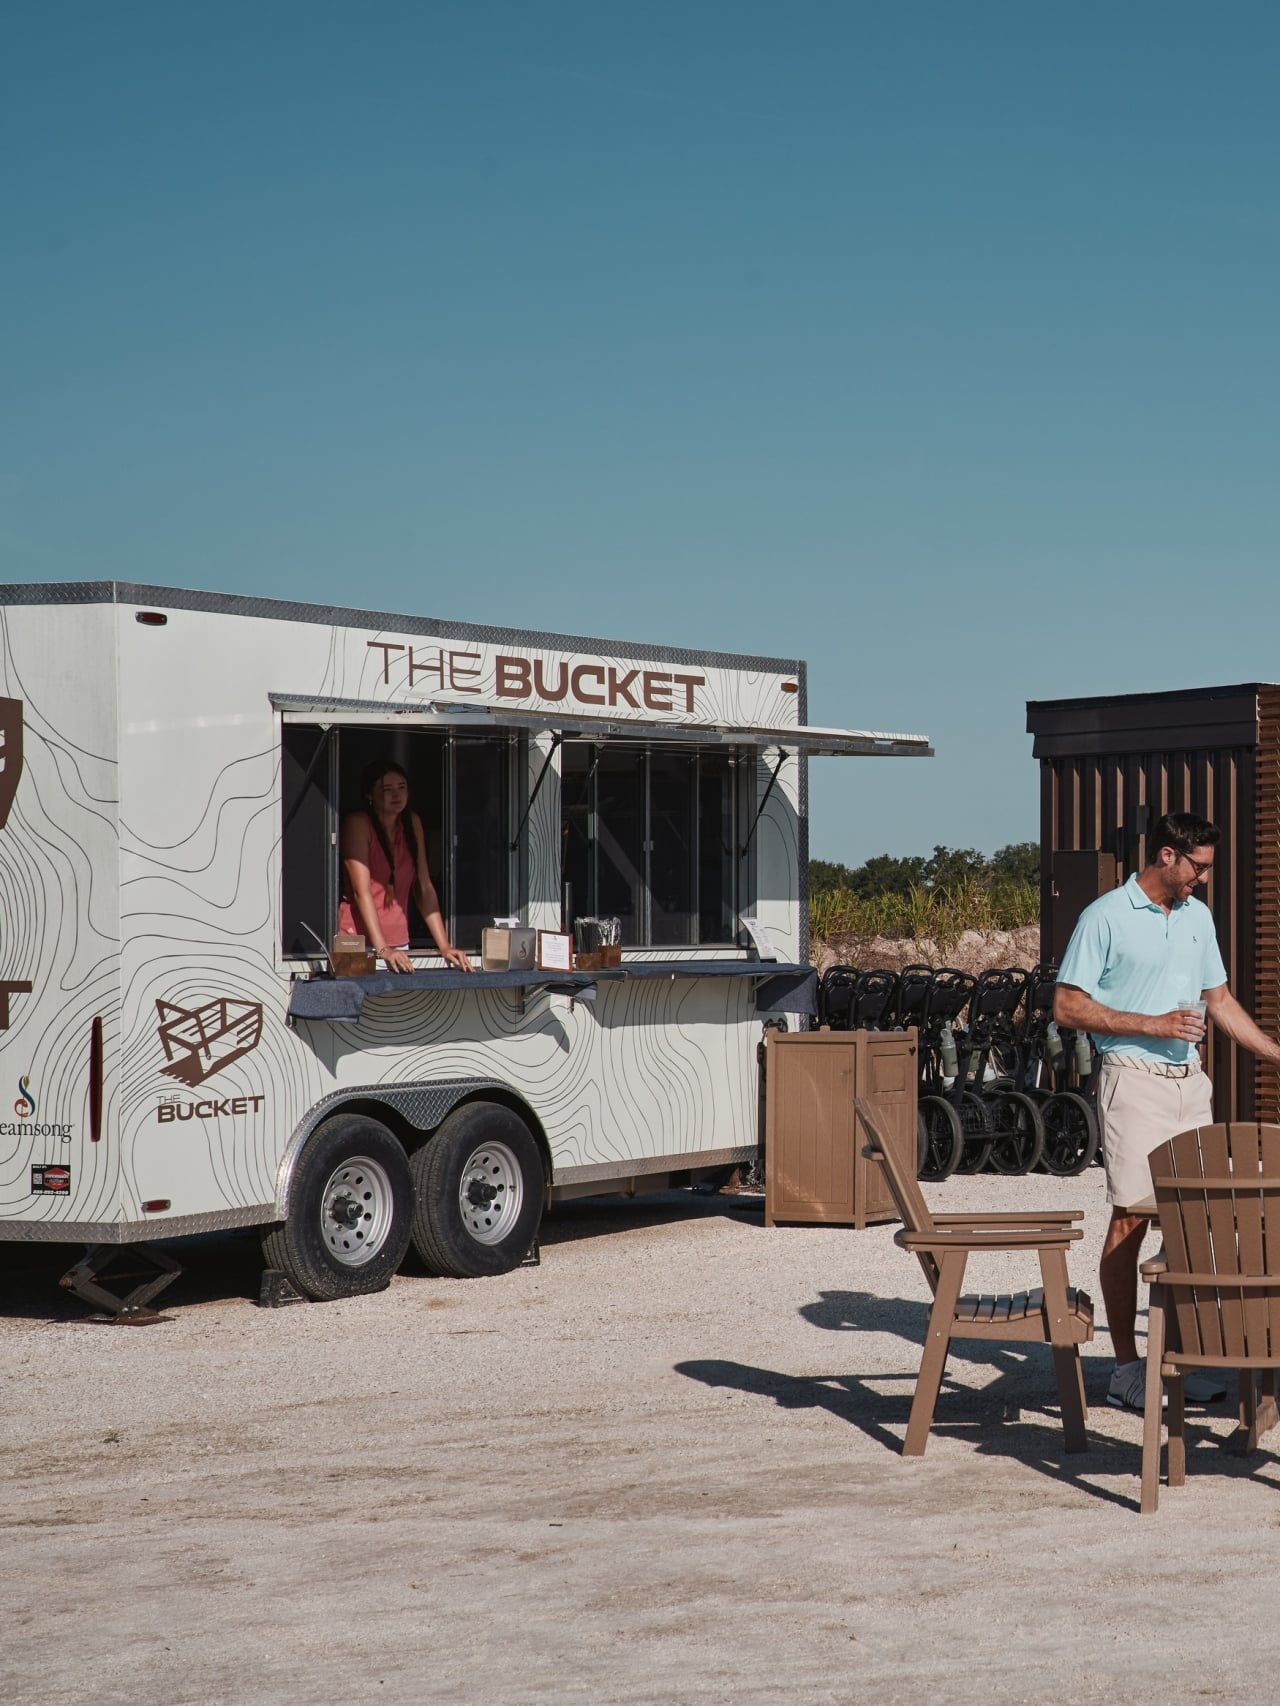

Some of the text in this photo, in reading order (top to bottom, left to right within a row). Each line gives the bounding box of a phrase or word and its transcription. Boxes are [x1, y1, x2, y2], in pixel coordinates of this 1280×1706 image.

[366, 640, 706, 713] THE BUCKET
[156, 1093, 180, 1105] THE
[157, 1095, 265, 1124] BUCKET
